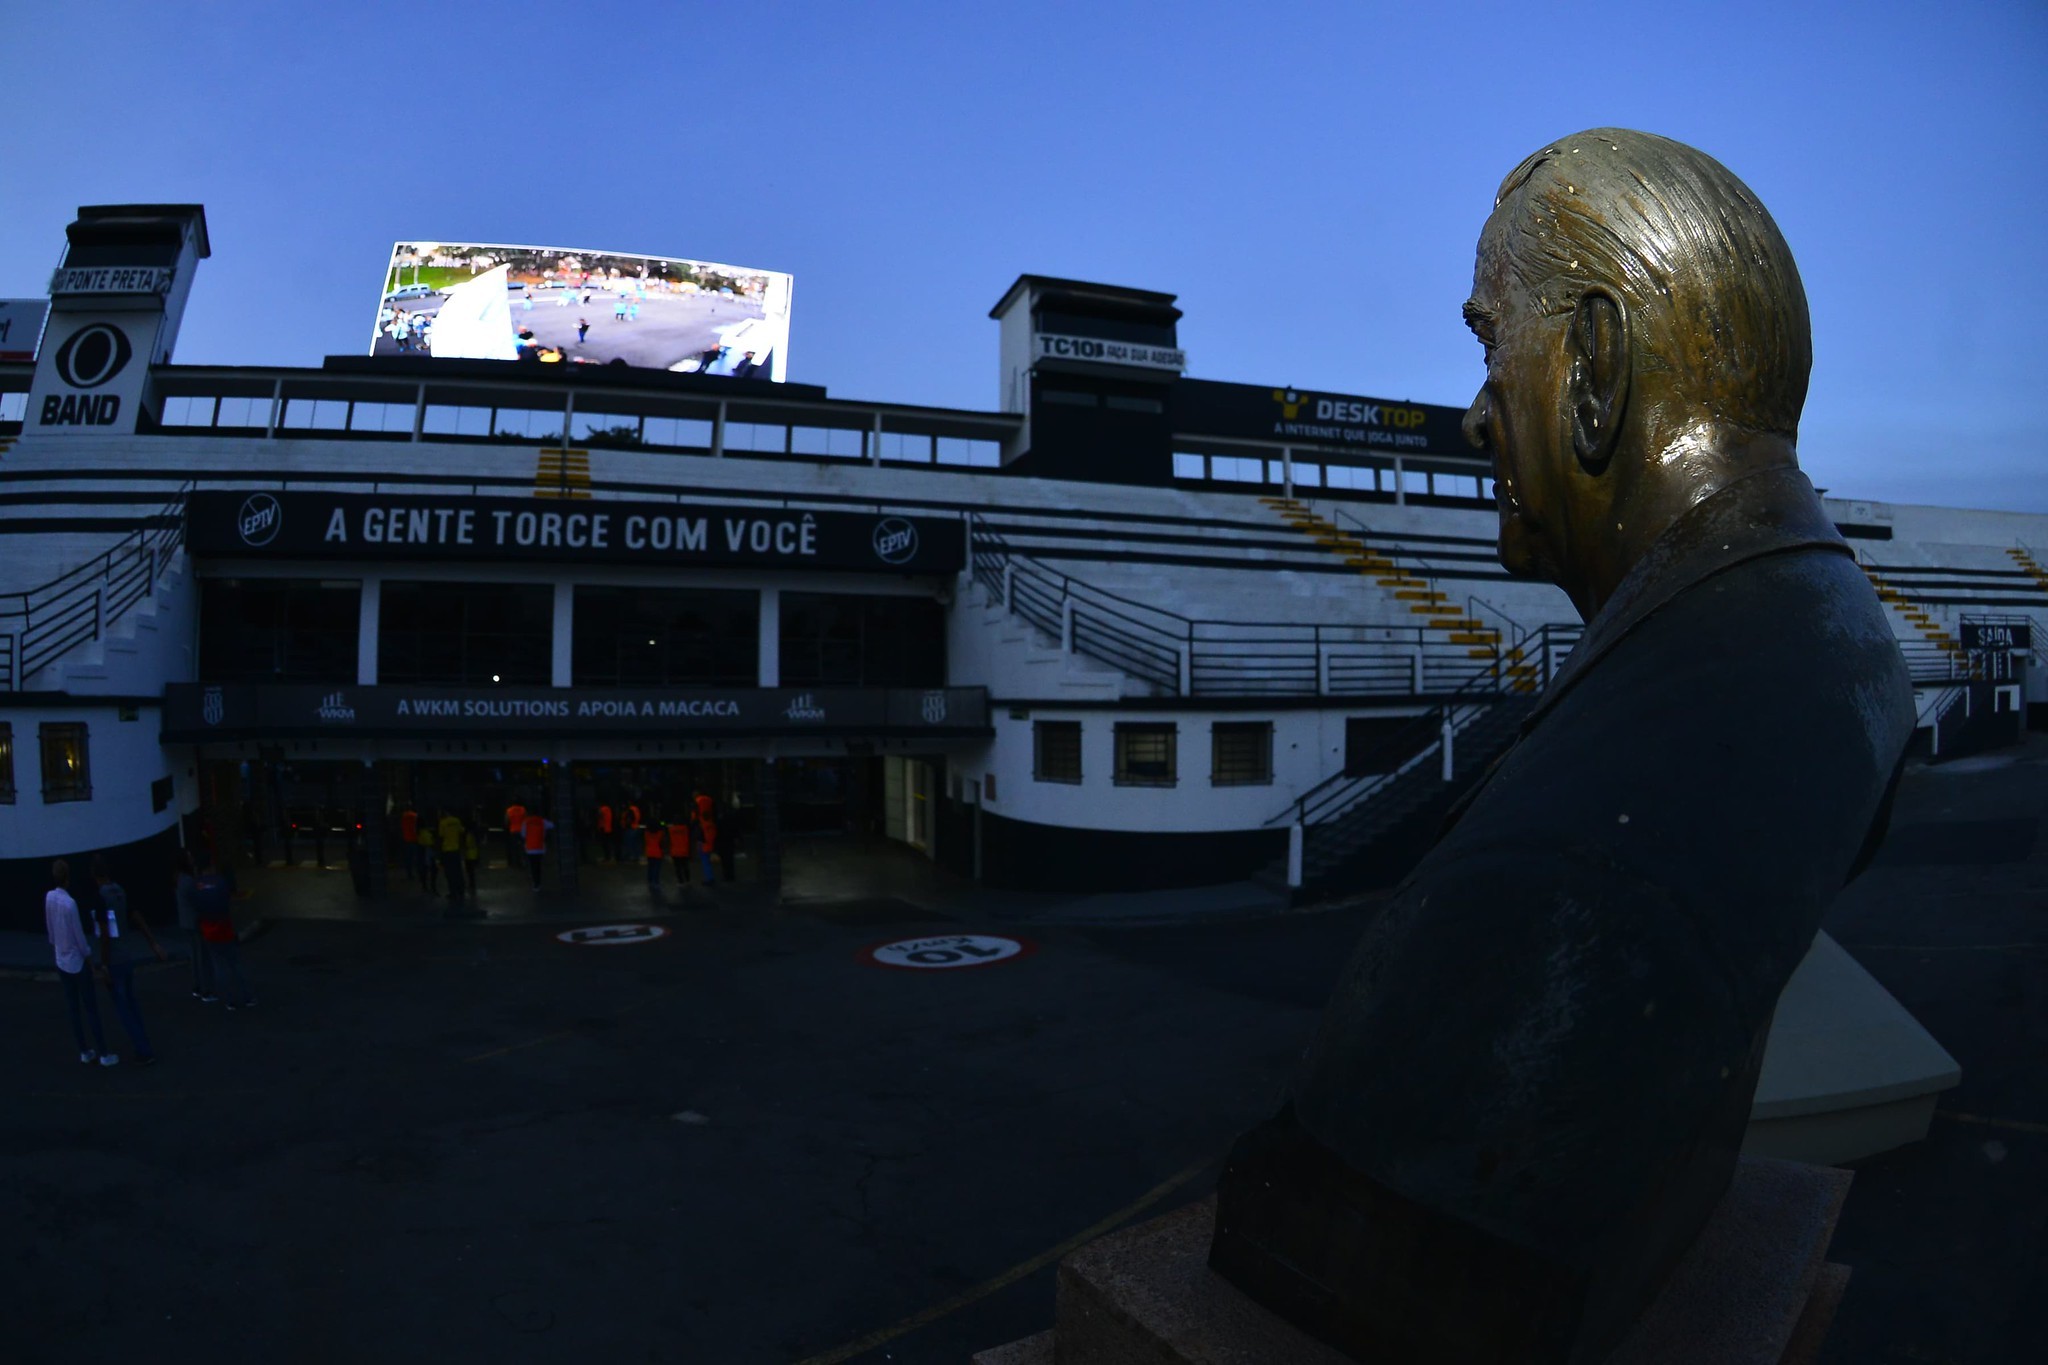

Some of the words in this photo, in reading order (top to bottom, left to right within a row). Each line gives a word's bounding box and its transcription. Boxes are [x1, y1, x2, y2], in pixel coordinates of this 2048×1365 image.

[66, 271, 109, 290] PONTE
[110, 270, 153, 289] PRETA
[40, 395, 121, 425] BAND
[1316, 399, 1426, 429] DESKTOP
[1274, 421, 1284, 434] A
[1285, 423, 1342, 439] INTERNET
[1343, 428, 1366, 442] QUE
[1395, 433, 1427, 448] JUNTO
[244, 502, 276, 536] EPTV
[324, 507, 347, 542] A
[363, 507, 475, 545] GENTE
[492, 510, 610, 548] TORCE
[625, 514, 708, 552] COM
[724, 513, 817, 556] VOCÊ
[880, 528, 912, 555] EPTV
[396, 699, 409, 715] A
[413, 699, 460, 716] WKM
[464, 699, 569, 717] SOLUTIONS
[578, 699, 636, 717] APOIA
[642, 699, 655, 716] A
[658, 699, 740, 717] MACACA
[908, 945, 1001, 964] 10
